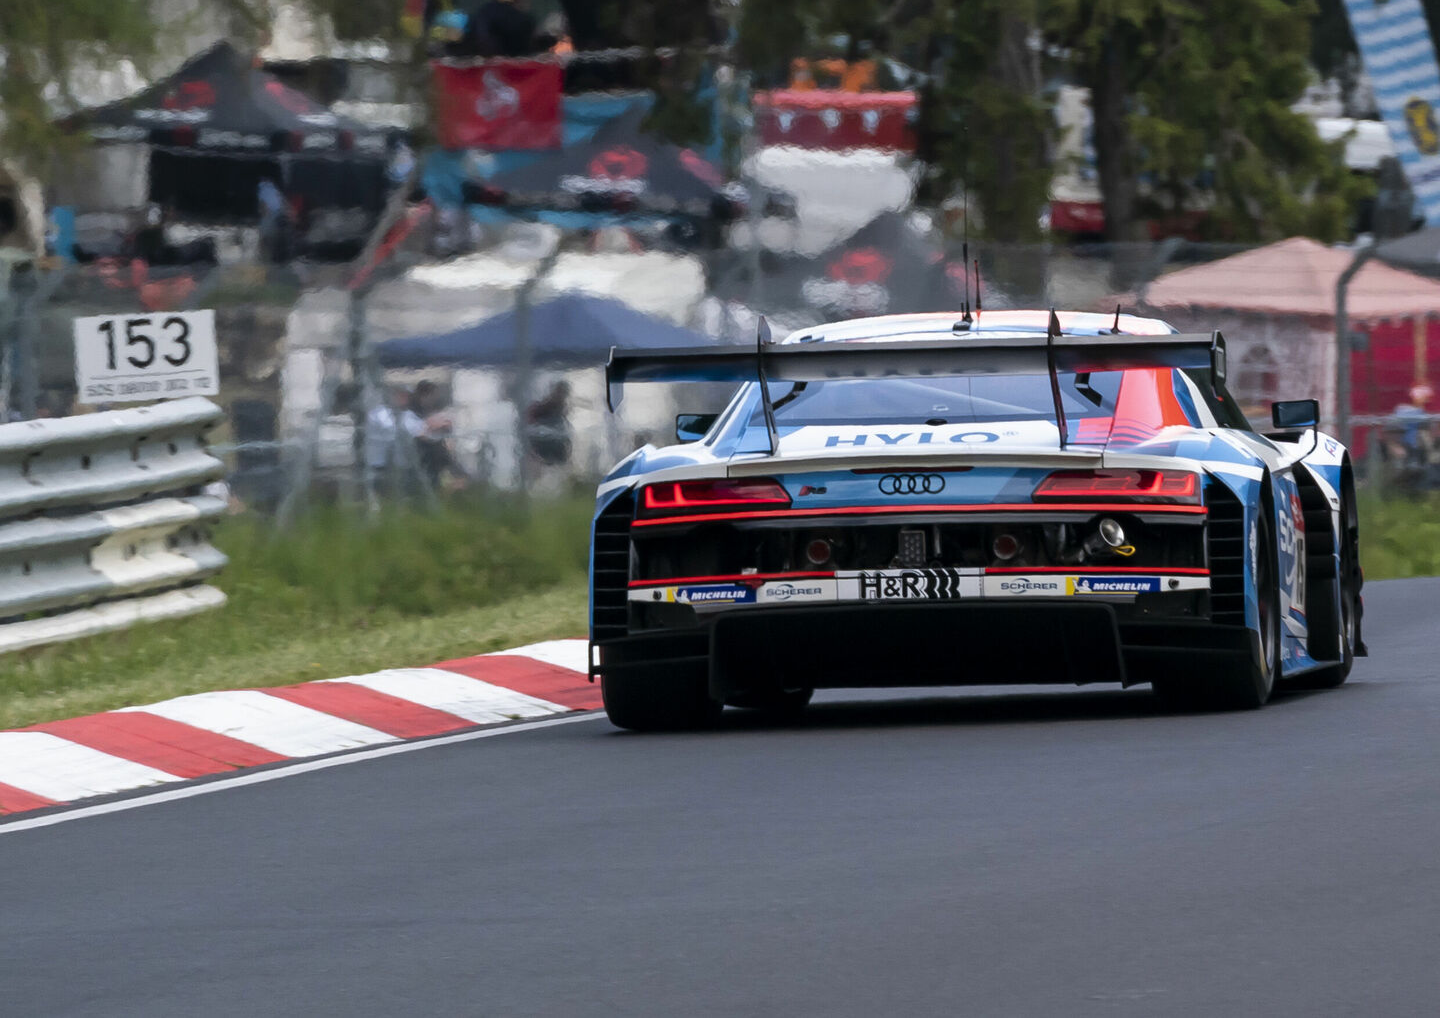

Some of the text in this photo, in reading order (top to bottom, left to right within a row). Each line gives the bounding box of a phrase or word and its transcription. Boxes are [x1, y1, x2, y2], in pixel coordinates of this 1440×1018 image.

[97, 316, 191, 370] 153
[825, 432, 1000, 447] HYLO
[860, 572, 921, 598] H&R
[1000, 582, 1058, 590] SCHERER
[1093, 583, 1150, 591] MICHELIN
[691, 590, 746, 600] MICHELIN
[766, 587, 822, 597] SCHERER
